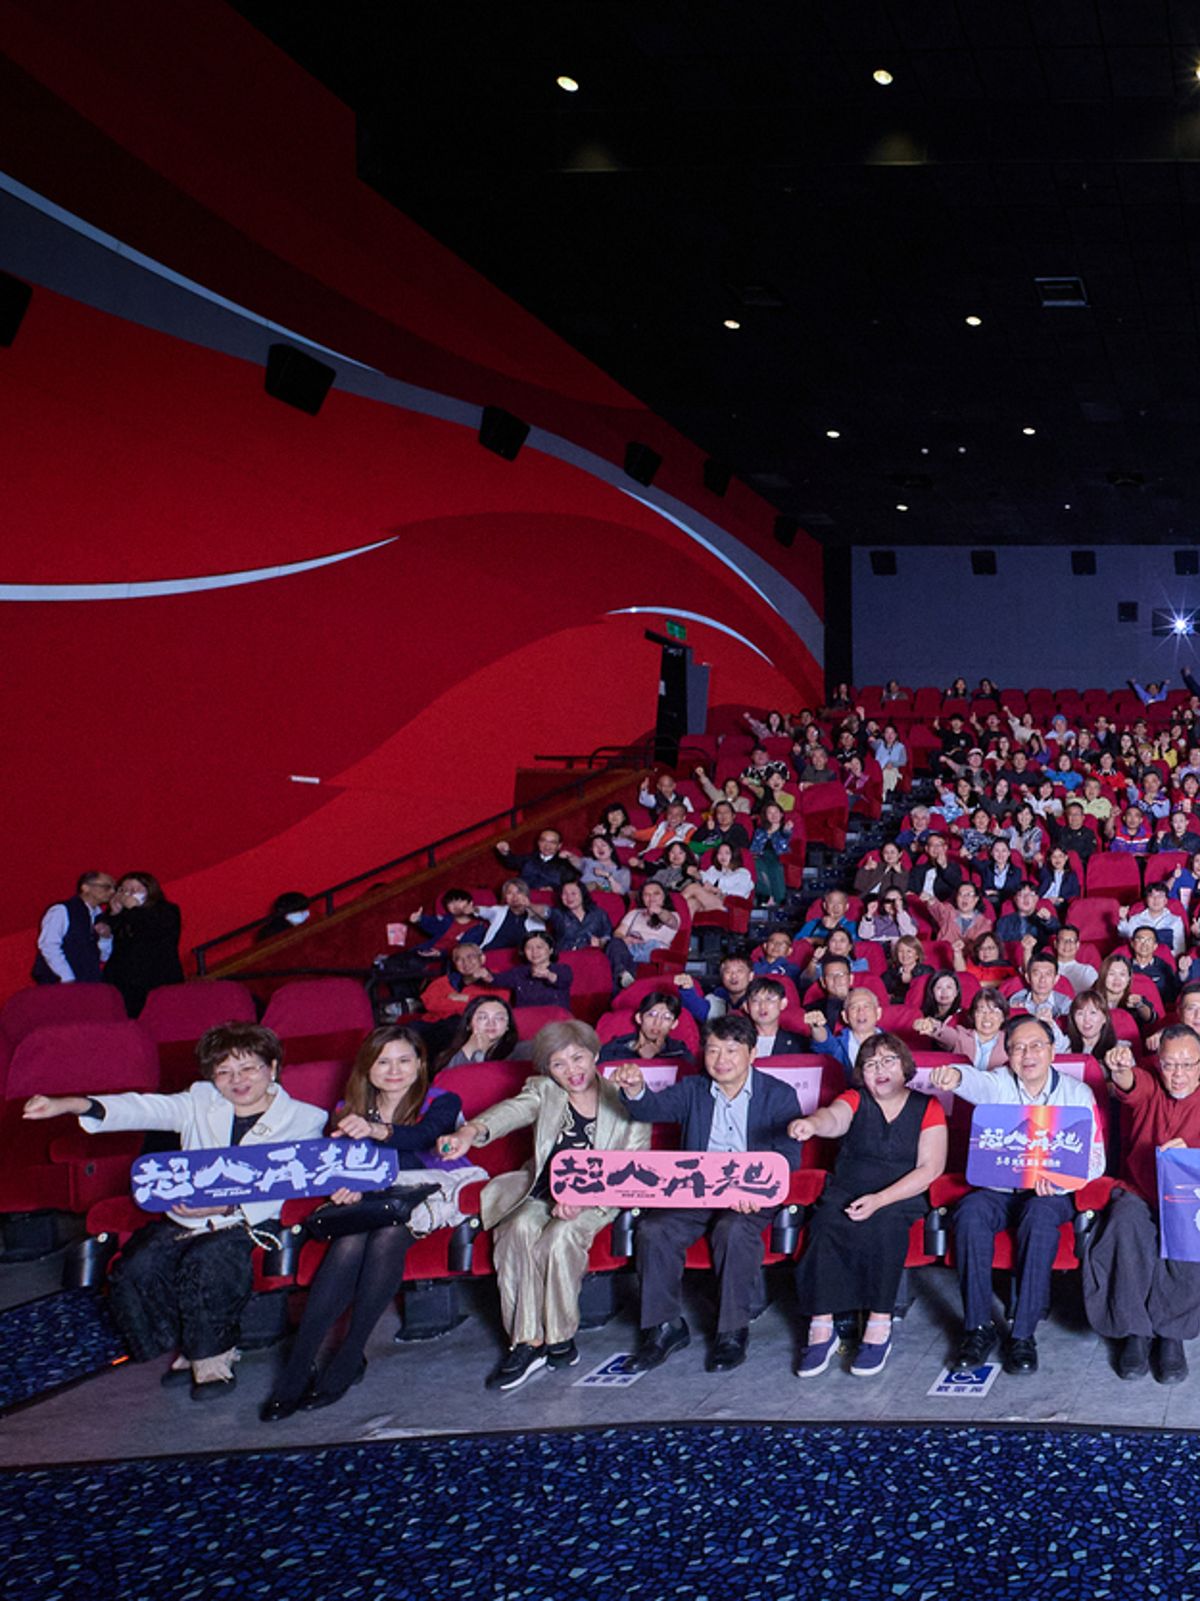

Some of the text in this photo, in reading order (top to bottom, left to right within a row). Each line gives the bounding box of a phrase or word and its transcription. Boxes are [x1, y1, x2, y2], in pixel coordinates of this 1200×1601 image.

[979, 1127, 1083, 1153] 超人再起
[133, 1142, 393, 1204] 超人再起
[553, 1156, 782, 1199] 超人再起
